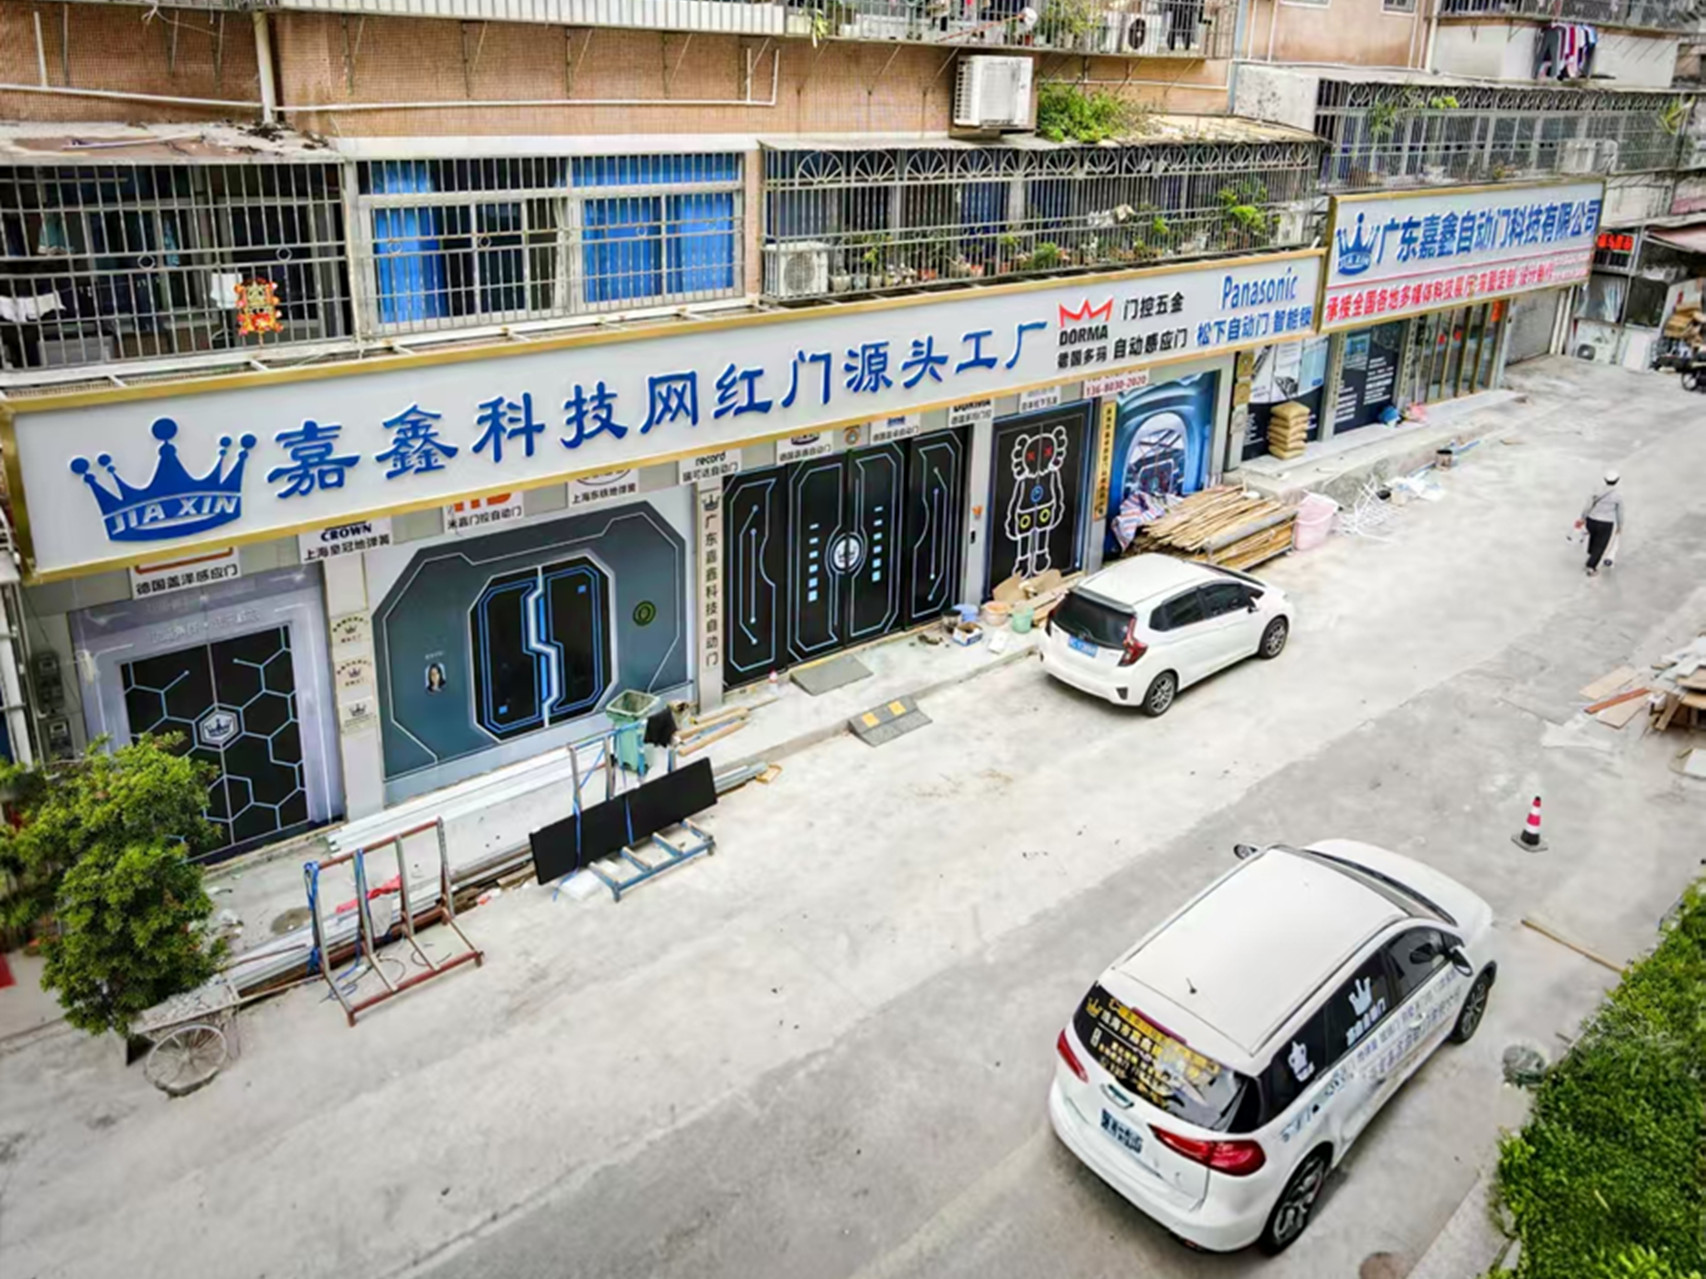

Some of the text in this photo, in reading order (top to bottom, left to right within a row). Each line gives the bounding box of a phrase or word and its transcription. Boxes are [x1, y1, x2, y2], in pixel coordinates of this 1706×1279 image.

[1376, 200, 1600, 264] 广东嘉鑫自动门科技有限公司
[1222, 266, 1298, 310] Panasonic
[1123, 291, 1185, 321] 门控五金
[1059, 324, 1109, 346] DORMA
[1113, 328, 1188, 360] 自动感应门
[1197, 313, 1268, 346] 松下自动门
[268, 321, 1048, 498] 嘉鑫科技网红门源头工厂
[695, 450, 727, 467] record
[112, 496, 238, 535] JIA XIN
[303, 533, 391, 562] 上海皇冠地弹簧
[320, 523, 373, 543] CROWN
